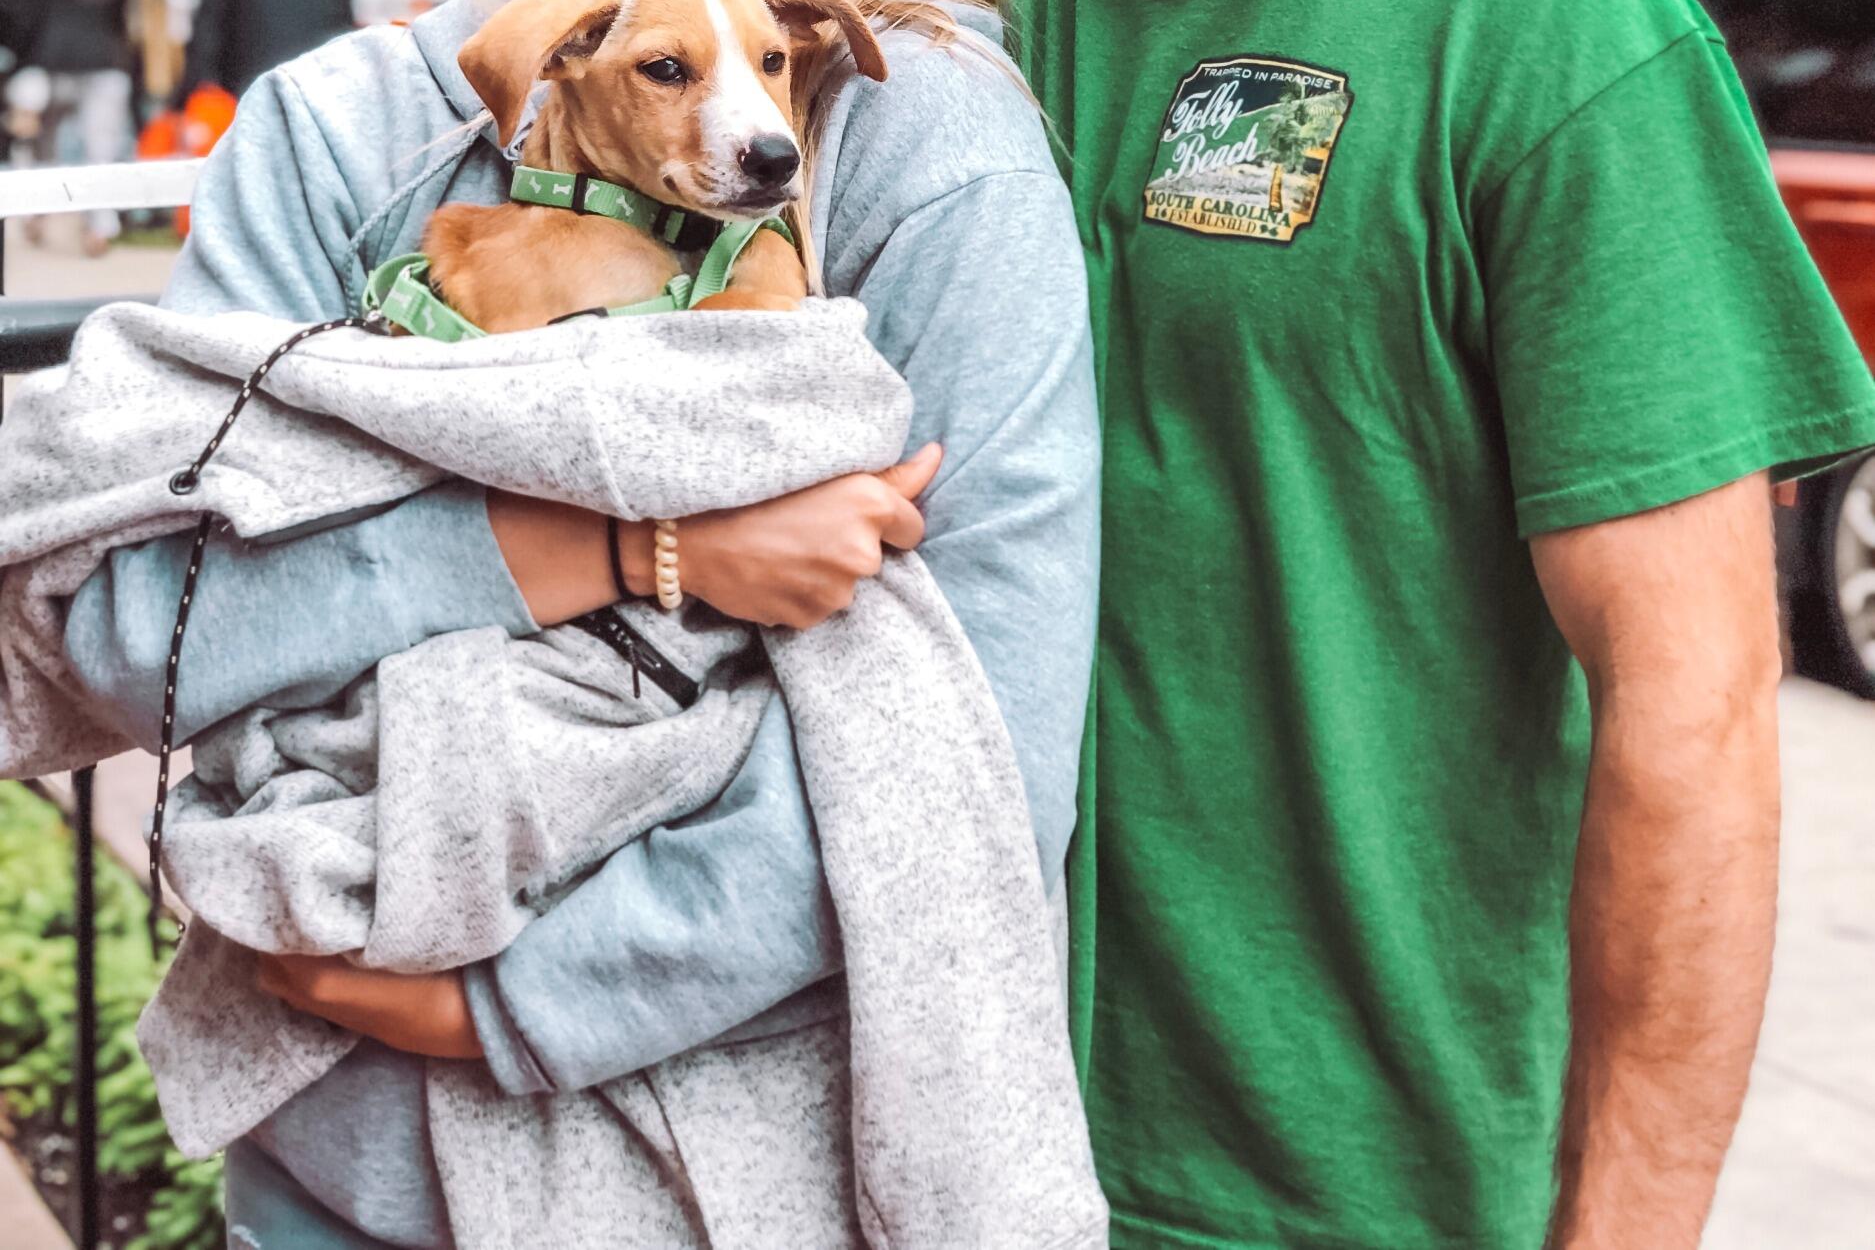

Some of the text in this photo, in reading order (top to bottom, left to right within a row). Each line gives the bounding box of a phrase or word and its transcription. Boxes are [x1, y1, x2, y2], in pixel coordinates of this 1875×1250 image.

[1203, 67, 1334, 89] TRAPPED IN PARADISE
[1163, 80, 1243, 141] Folly
[1164, 122, 1259, 182] Beach
[1148, 190, 1292, 228] SOUTH CAROLINA
[1168, 209, 1257, 234] ESTABLISHED
